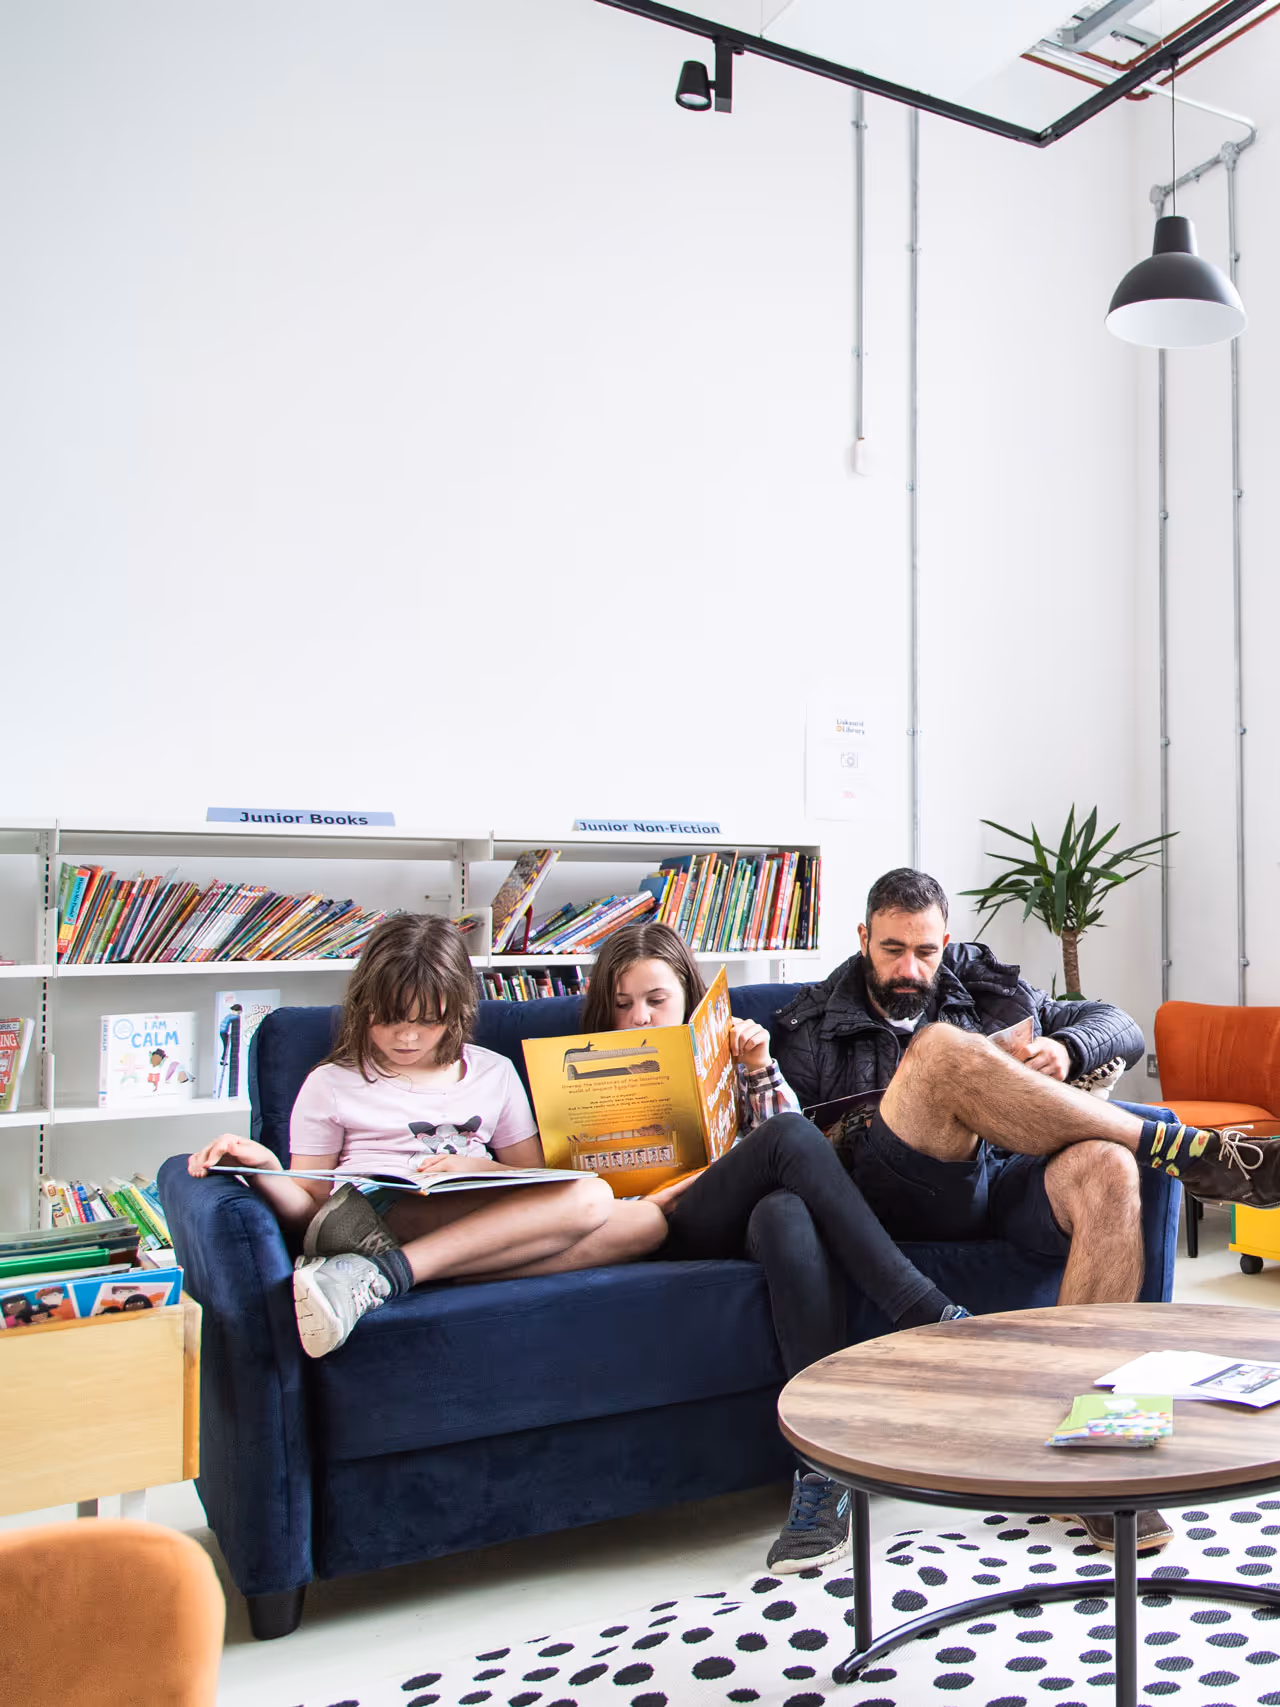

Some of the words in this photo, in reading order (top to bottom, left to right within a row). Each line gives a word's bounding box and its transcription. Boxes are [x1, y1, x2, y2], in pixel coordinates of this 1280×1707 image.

[239, 811, 303, 824] Junior
[310, 813, 369, 825] Books
[579, 822, 629, 832] Junior
[633, 823, 721, 834] Non-Fiction
[151, 1020, 167, 1030] AM
[131, 1030, 179, 1048] CALM
